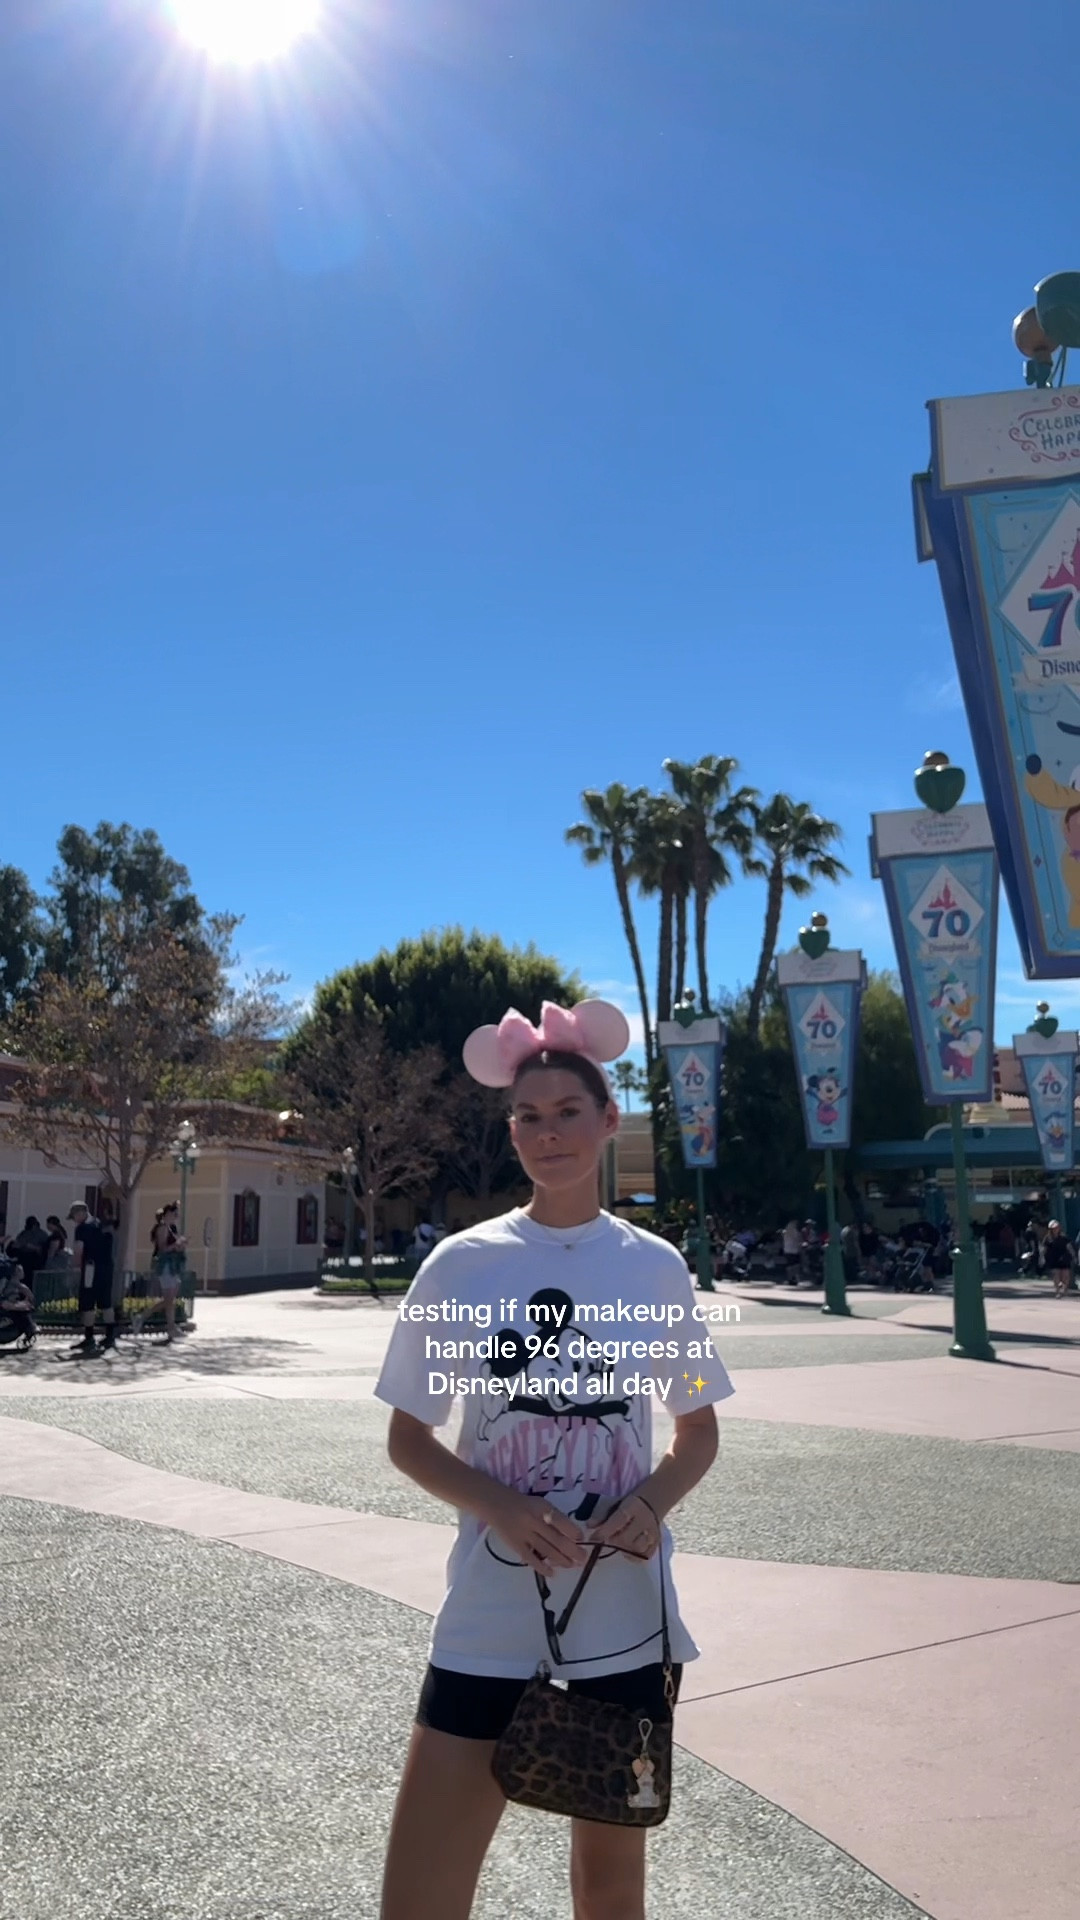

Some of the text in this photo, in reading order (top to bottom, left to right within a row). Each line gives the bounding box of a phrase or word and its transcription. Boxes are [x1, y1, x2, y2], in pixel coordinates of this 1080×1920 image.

[921, 909, 971, 938] 70
[806, 1020, 837, 1039] 70
[682, 1072, 705, 1087] 70
[1038, 1080, 1062, 1095] 70
